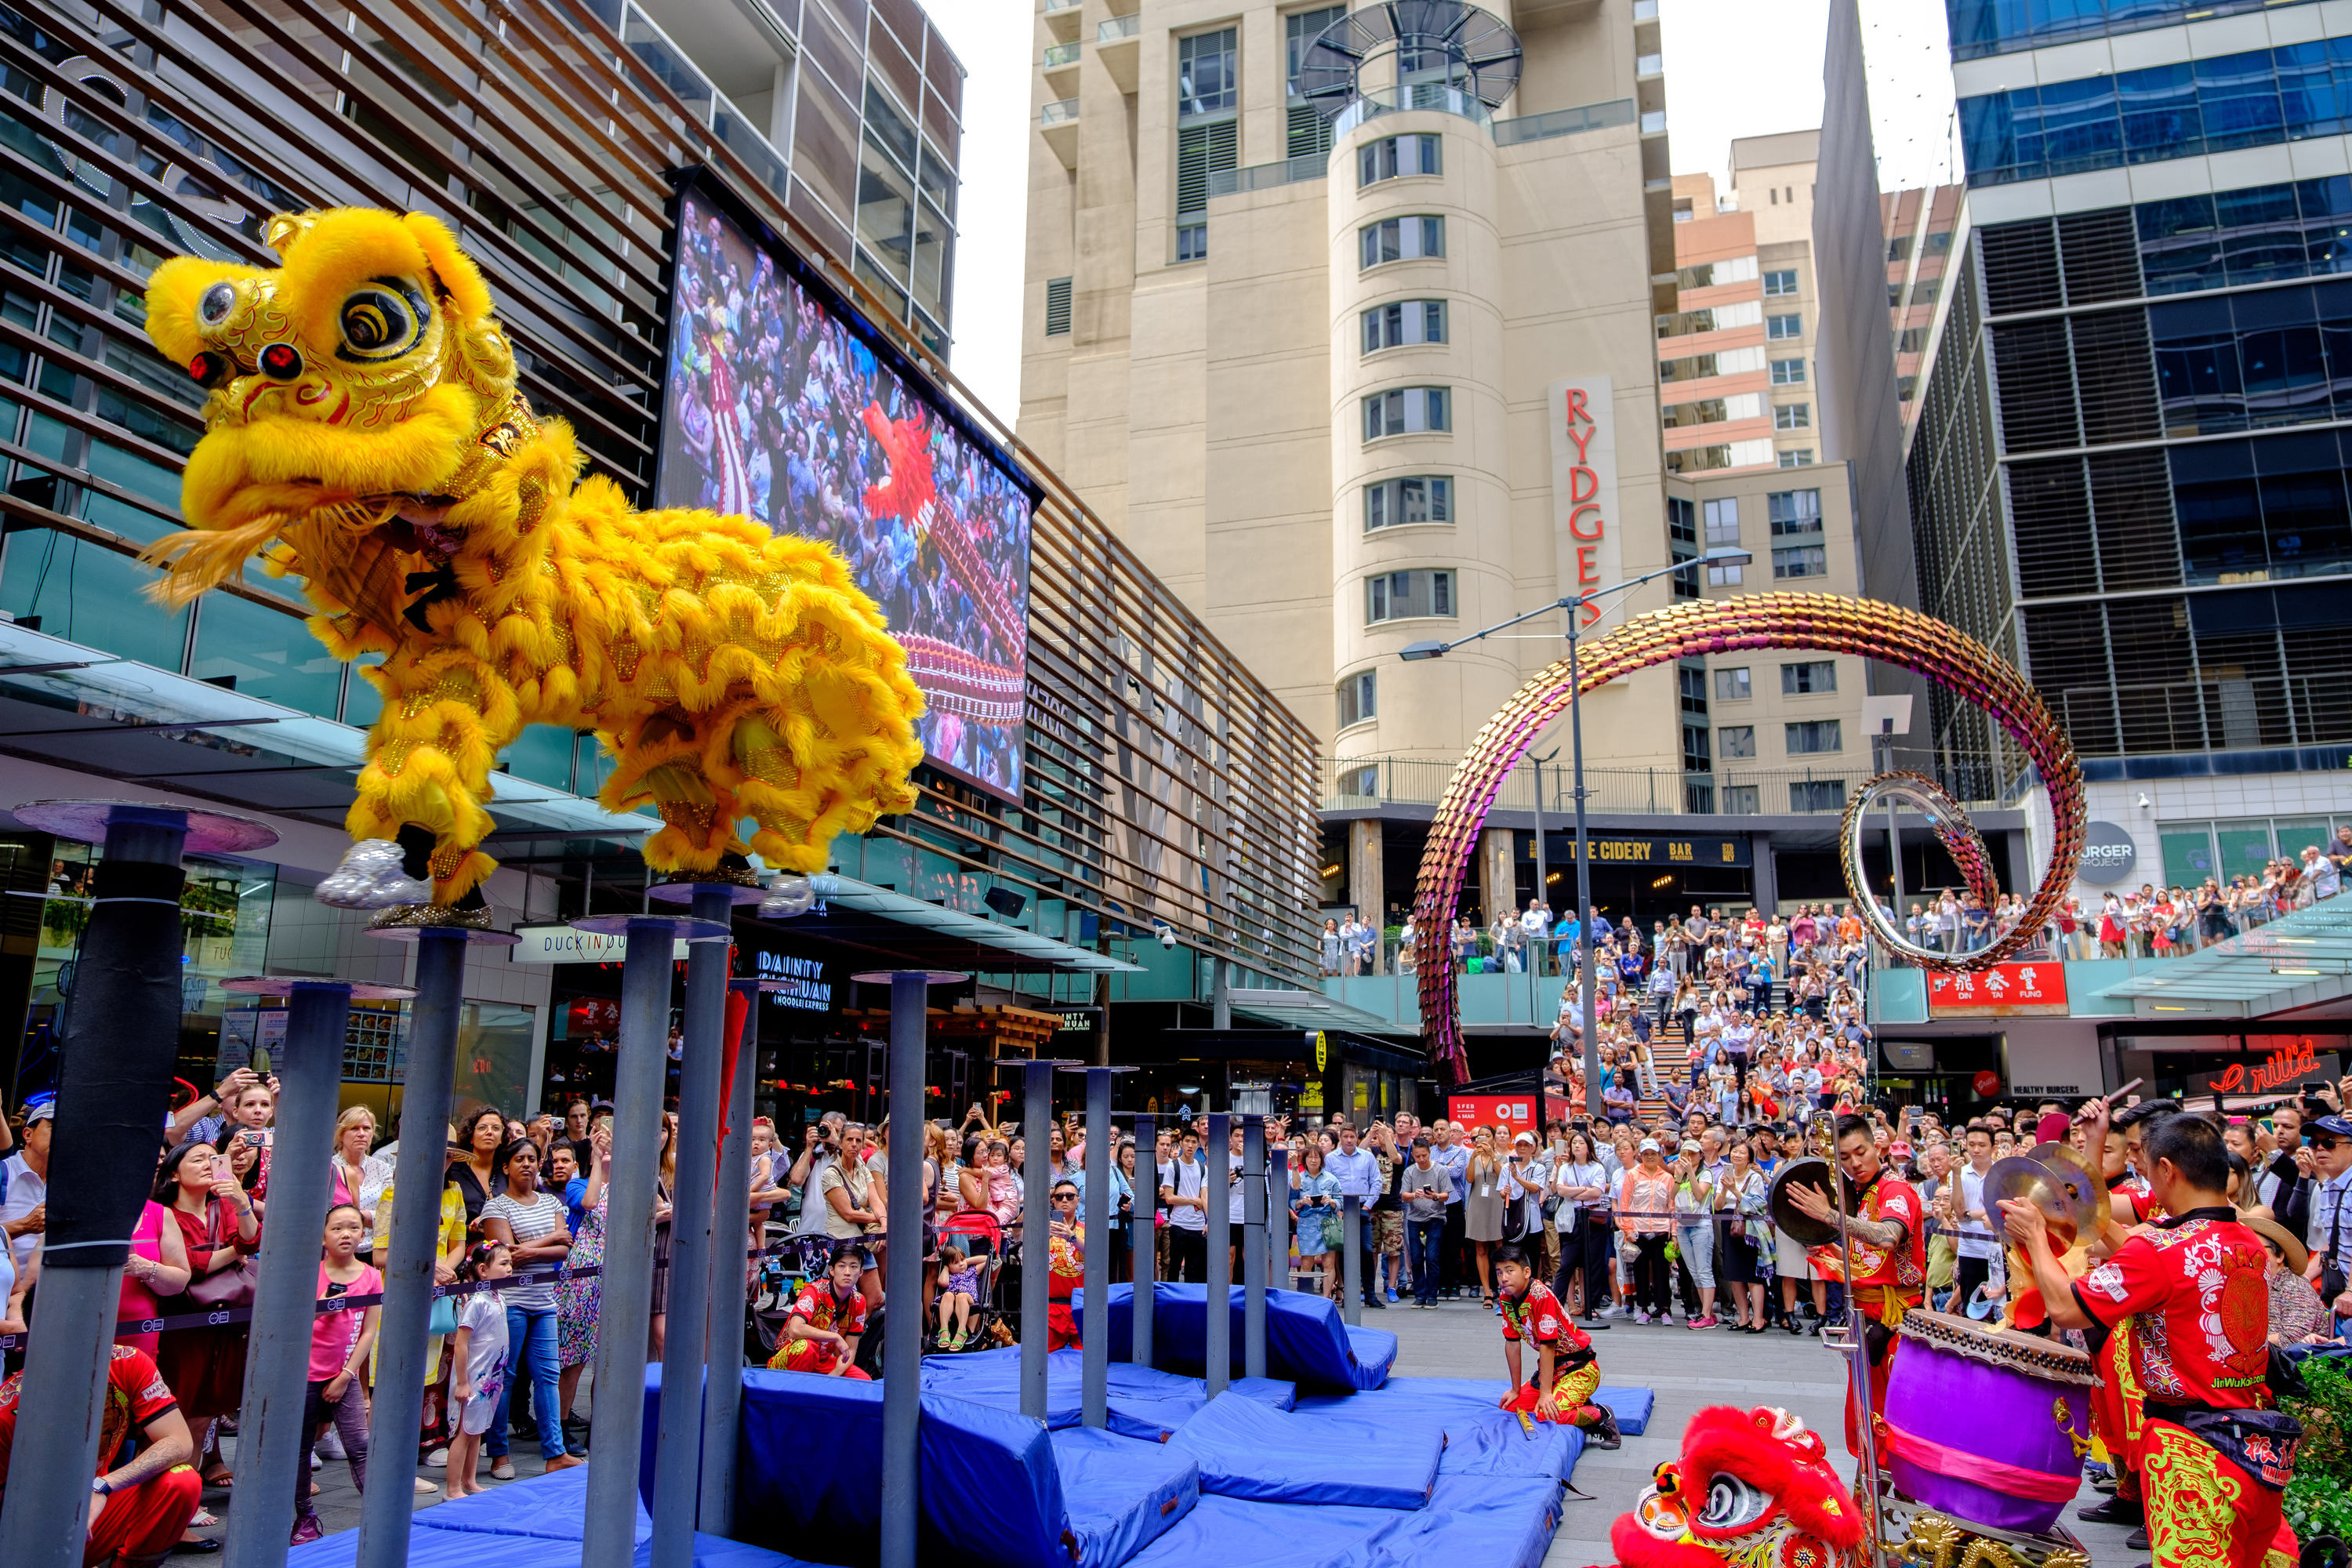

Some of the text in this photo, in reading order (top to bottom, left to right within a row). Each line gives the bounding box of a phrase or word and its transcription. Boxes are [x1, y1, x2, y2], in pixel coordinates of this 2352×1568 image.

[1566, 388, 1604, 626] RYDGES
[1567, 841, 1652, 860] TE CIDERY
[1668, 842, 1692, 856] BAR
[2081, 844, 2132, 858] URGER
[758, 951, 823, 980] DAINTY
[804, 1000, 829, 1011] EXPRESS
[2209, 1039, 2321, 1094] Grill'd
[1976, 1076, 1997, 1091] Grill'd
[2013, 1086, 2080, 1094] HEALTHY BURGERS
[2107, 1282, 2123, 1297] CITY
[145, 1383, 165, 1398] MARK
